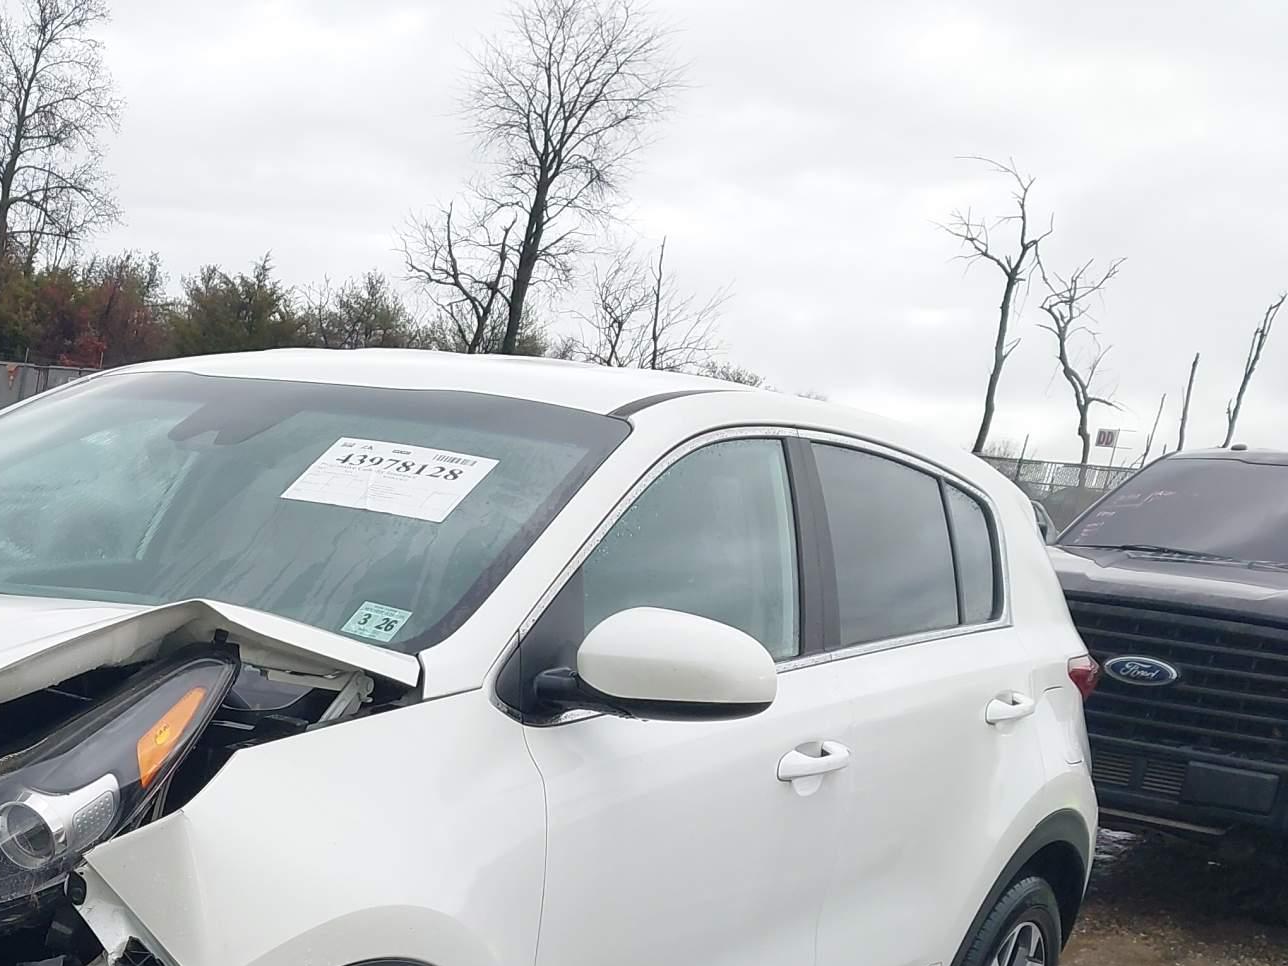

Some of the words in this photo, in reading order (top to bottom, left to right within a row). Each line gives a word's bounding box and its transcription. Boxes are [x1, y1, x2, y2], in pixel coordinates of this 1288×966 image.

[335, 452, 464, 481] 43978128
[357, 613, 372, 626] 3
[374, 617, 399, 632] 26
[1119, 661, 1161, 679] Ford
